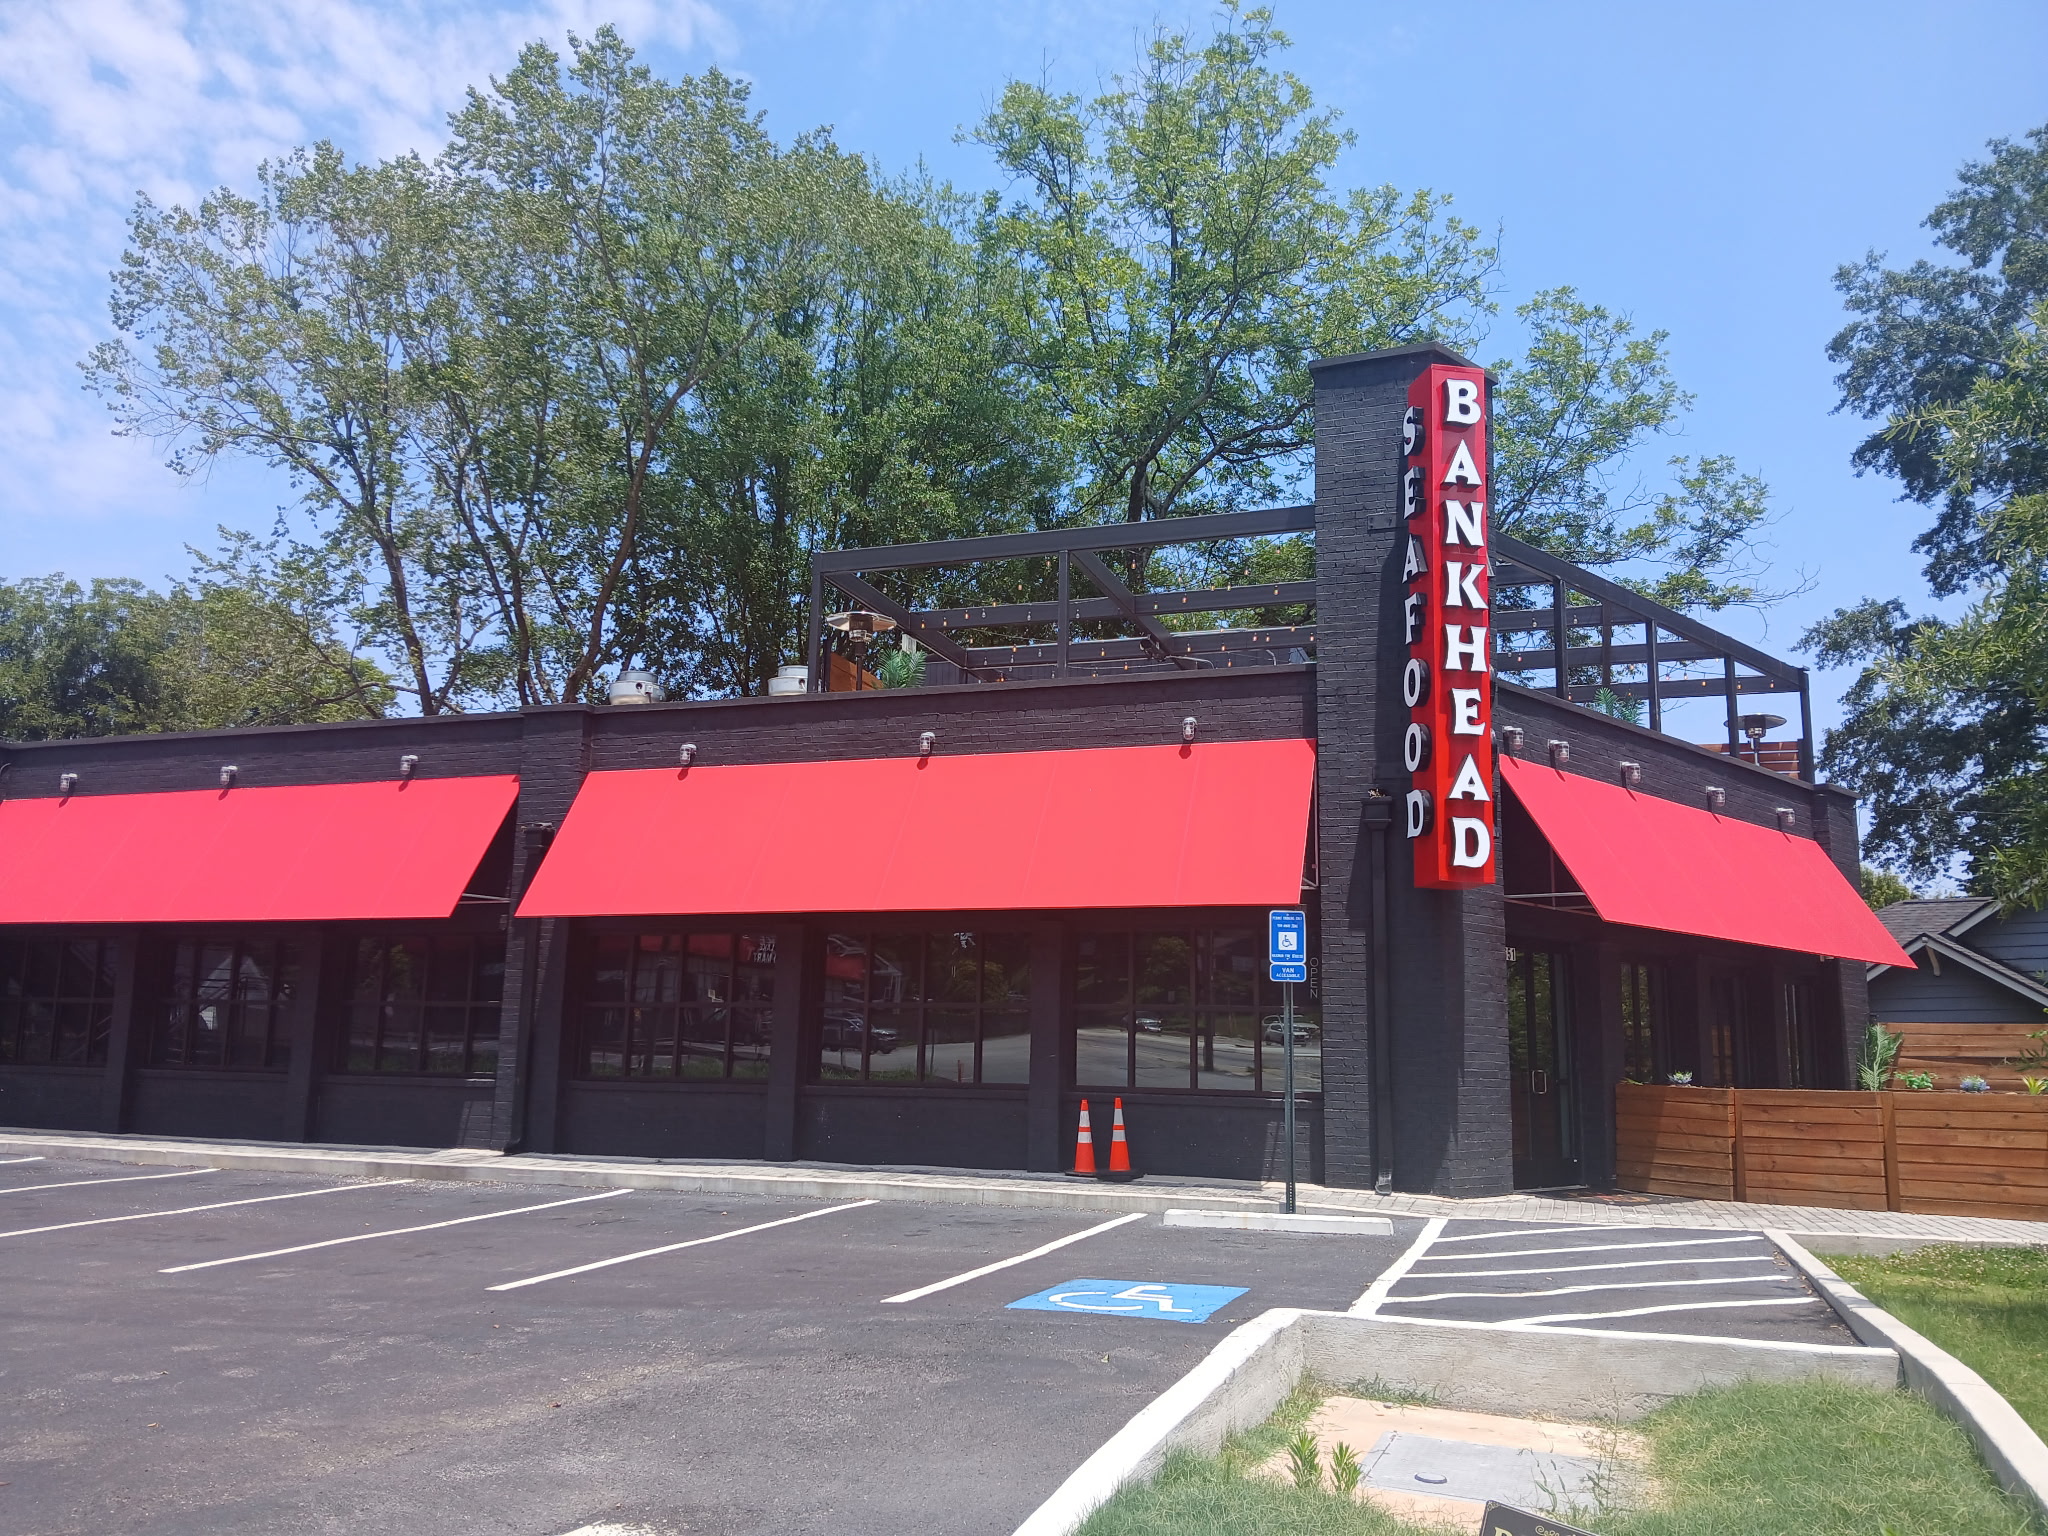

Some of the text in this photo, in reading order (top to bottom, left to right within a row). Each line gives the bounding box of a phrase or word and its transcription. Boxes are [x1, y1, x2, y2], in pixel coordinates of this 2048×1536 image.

[1402, 405, 1425, 839] SEAFOOD
[1444, 378, 1491, 868] BANKHEAD
[1310, 957, 1319, 999] OPEN
